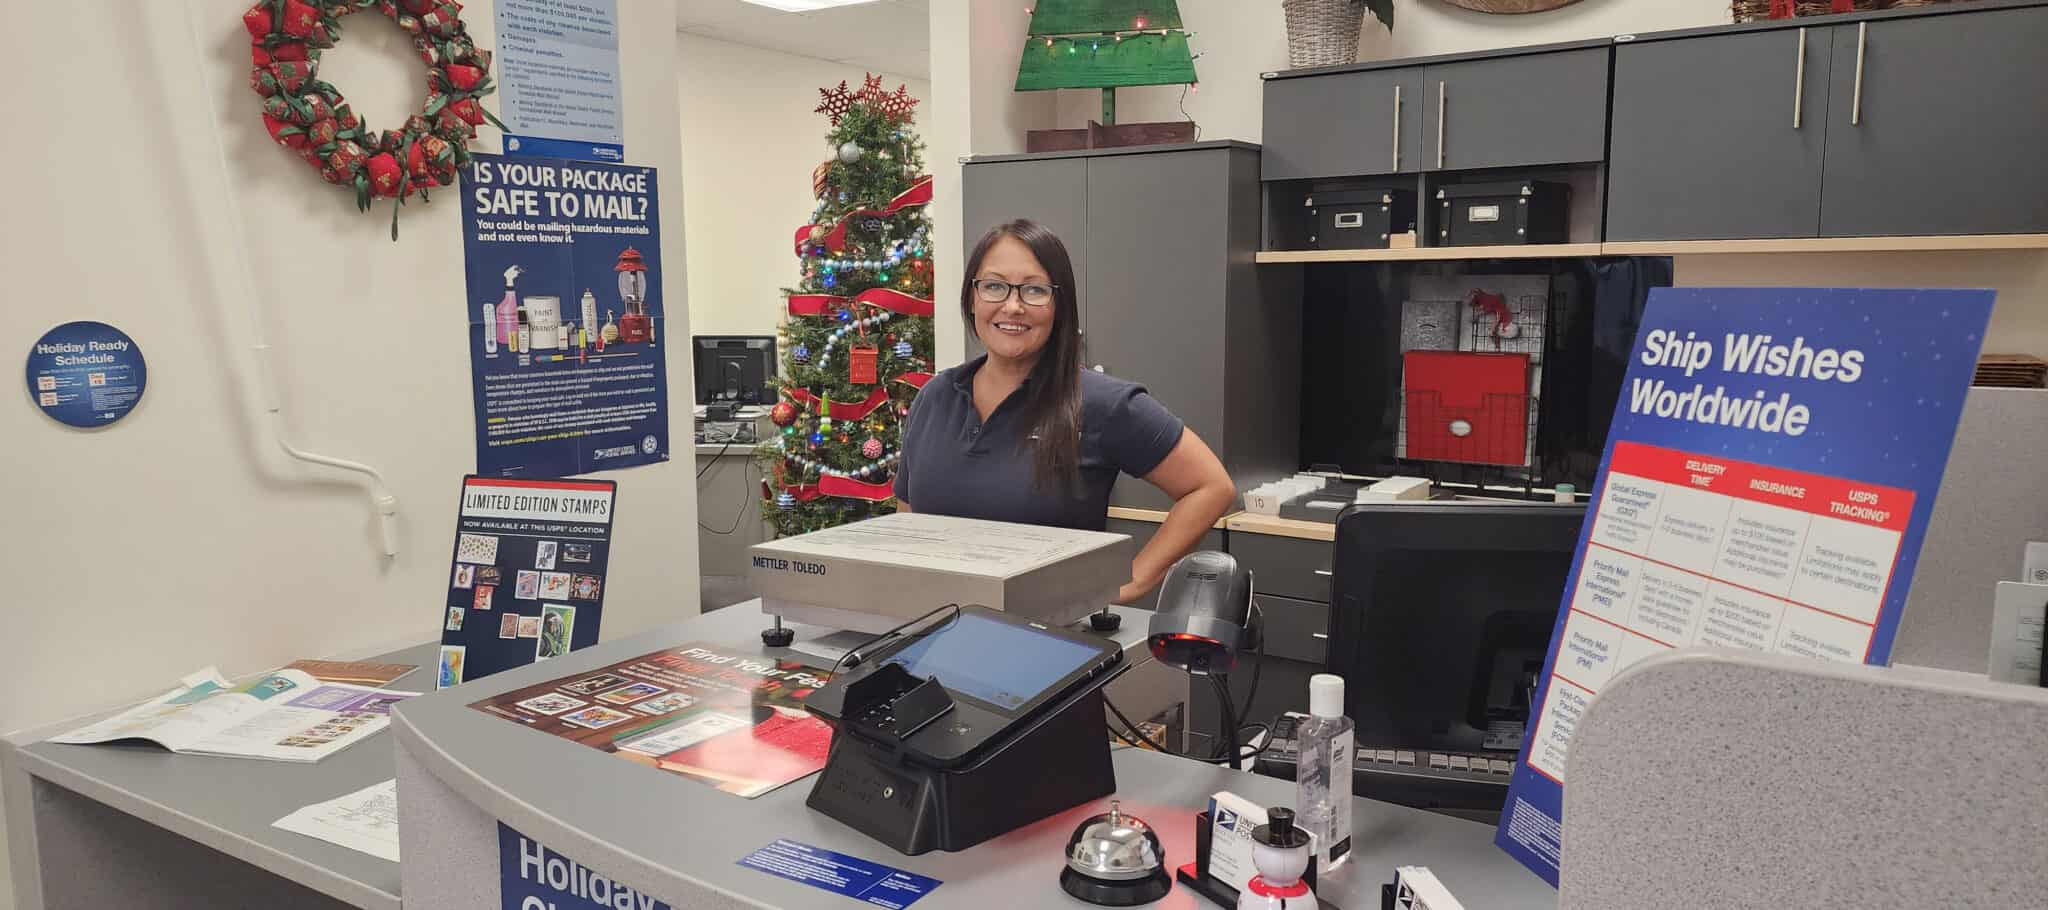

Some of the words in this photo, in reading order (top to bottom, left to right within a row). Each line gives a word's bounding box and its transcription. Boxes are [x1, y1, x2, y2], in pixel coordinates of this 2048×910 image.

[474, 162, 493, 184] IS
[497, 163, 556, 188] YOUR
[562, 168, 648, 194] PACKAGE
[475, 188, 540, 216] SAFE
[544, 192, 580, 218] TO
[584, 194, 648, 221] MAIL?
[476, 219, 494, 230] You
[496, 220, 521, 231] could
[524, 221, 536, 232] be
[538, 222, 570, 235] mailing
[572, 223, 612, 234] hazardous
[614, 224, 650, 235] materials
[478, 232, 496, 242] and
[498, 232, 514, 242] not
[516, 234, 537, 242] even
[538, 232, 563, 244] know
[36, 342, 86, 354] Holiday
[88, 340, 129, 352] Ready
[1641, 329, 1712, 376] Ship
[1722, 333, 1864, 382] Wishes
[55, 353, 115, 366] Schedule
[1630, 378, 1810, 436] Worldwide
[1686, 459, 1727, 476] DELIVERY
[1750, 479, 1806, 498] INSURANCE
[1848, 490, 1878, 505] USPS
[466, 494, 510, 510] LIMITED
[514, 496, 558, 512] EDITION
[561, 498, 607, 515] STAMPS
[482, 522, 518, 530] AVAILABLE
[568, 526, 604, 534] LOCATION
[753, 556, 788, 570] METTLER
[793, 560, 826, 576] TOLEDO
[680, 648, 737, 664] Find
[736, 659, 788, 677] Your
